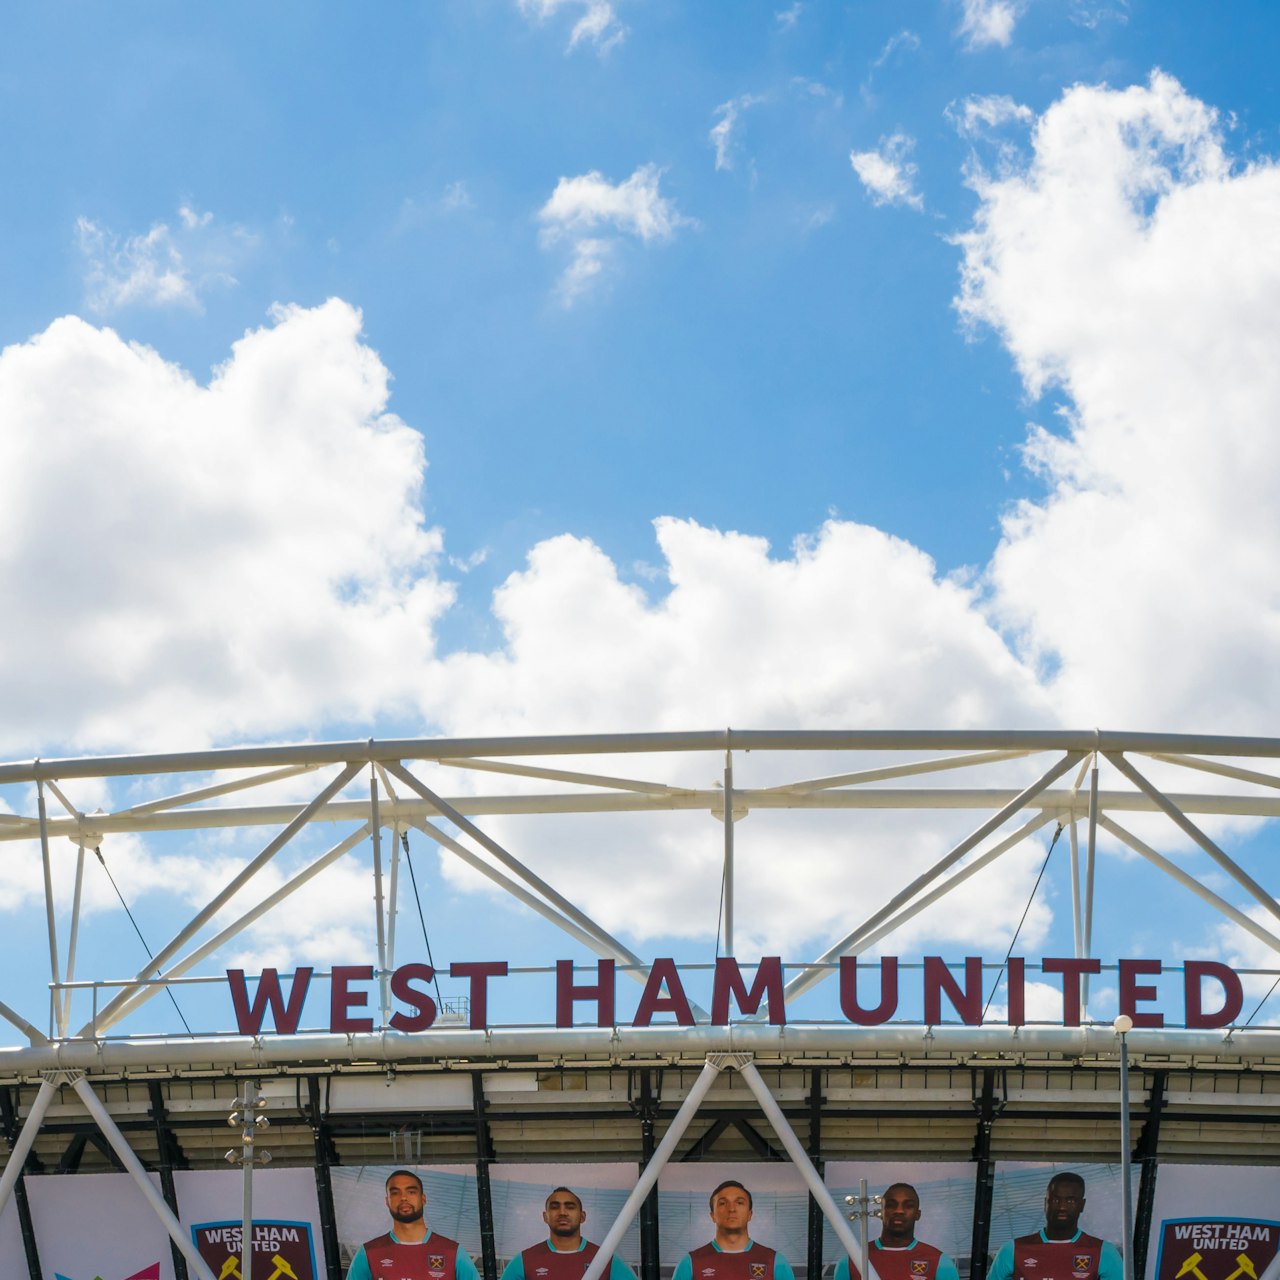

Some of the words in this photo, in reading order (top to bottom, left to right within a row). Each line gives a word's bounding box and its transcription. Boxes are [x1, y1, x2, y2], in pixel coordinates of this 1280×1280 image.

[226, 961, 508, 1036] WEST
[556, 956, 786, 1028] HAM
[839, 956, 1244, 1029] UNITED
[205, 1227, 244, 1243] WES
[255, 1227, 299, 1242] HAM
[1174, 1225, 1224, 1240] WEST
[1226, 1225, 1270, 1241] HAM
[226, 1241, 280, 1252] UNTED
[1192, 1239, 1248, 1250] UNITED
